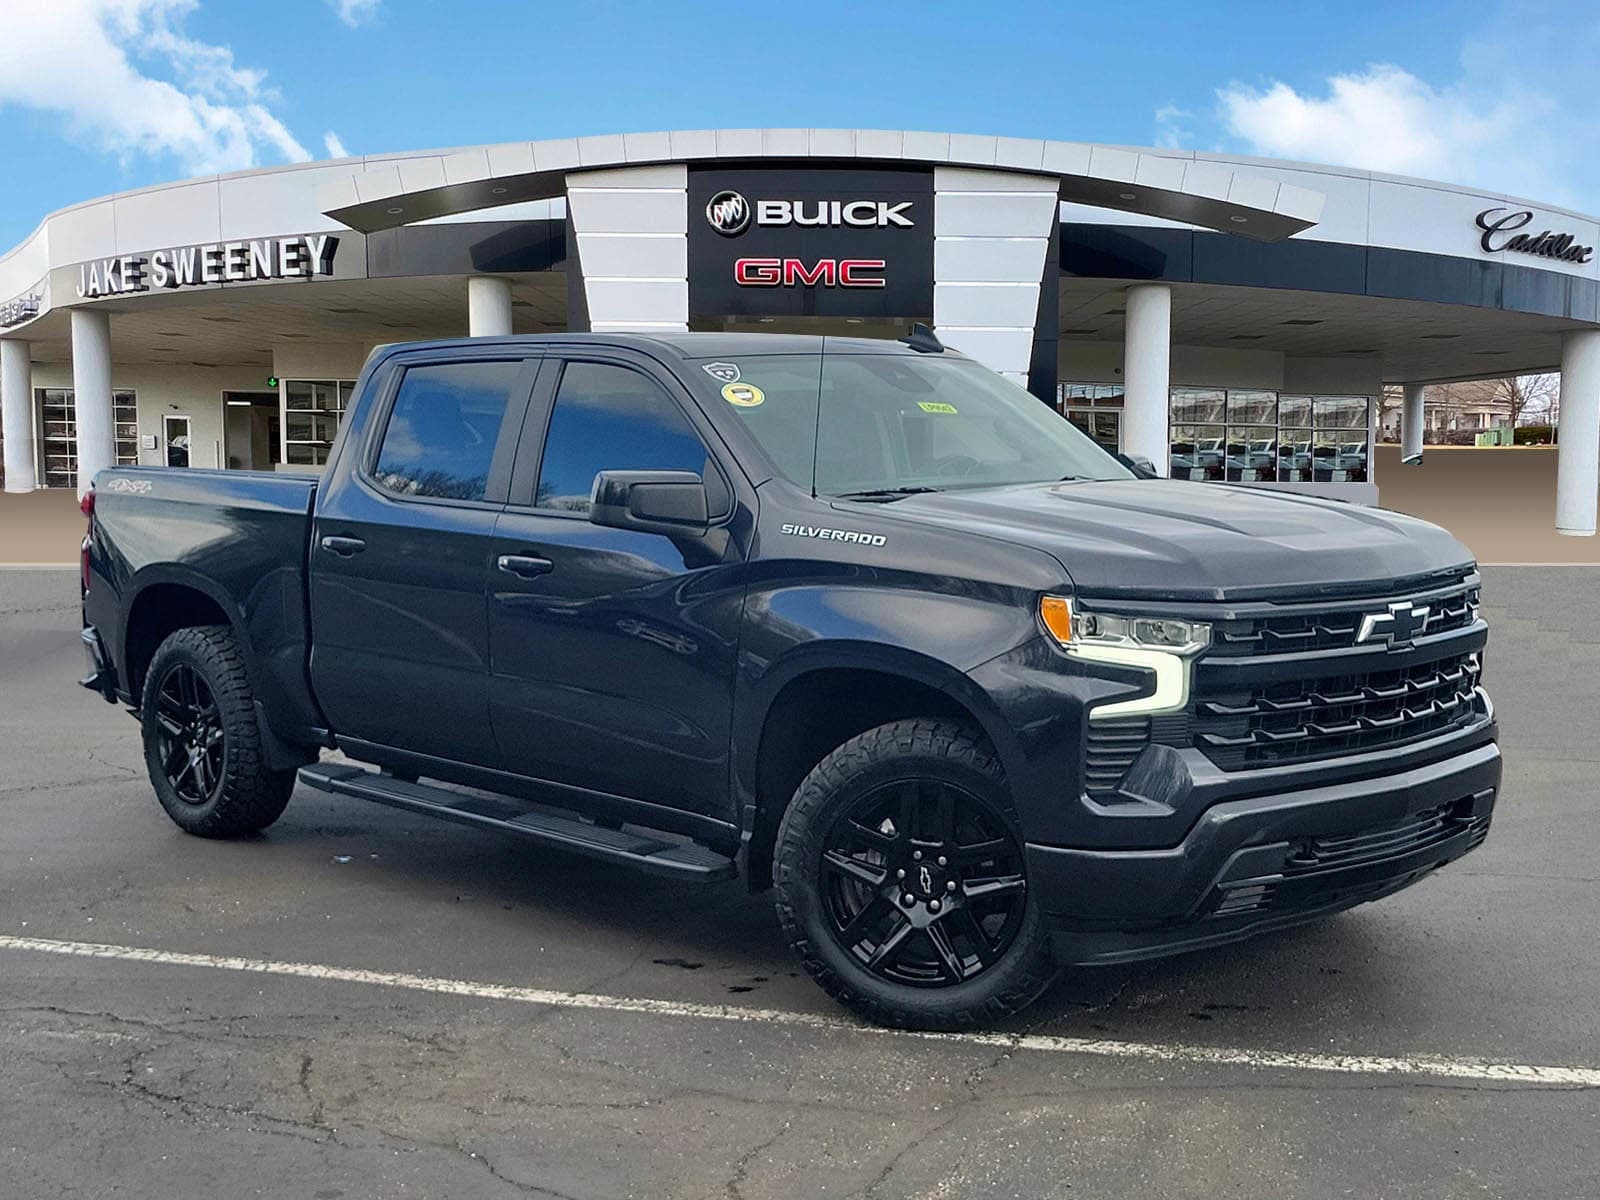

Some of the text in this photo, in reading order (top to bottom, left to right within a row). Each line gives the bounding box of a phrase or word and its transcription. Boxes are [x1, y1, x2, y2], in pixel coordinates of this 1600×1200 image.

[757, 200, 915, 226] BUICK
[1476, 207, 1593, 263] Cadillac
[76, 235, 333, 298] JAKE SWEENEY
[734, 258, 886, 287] GMC
[781, 523, 887, 546] SILVERADO
